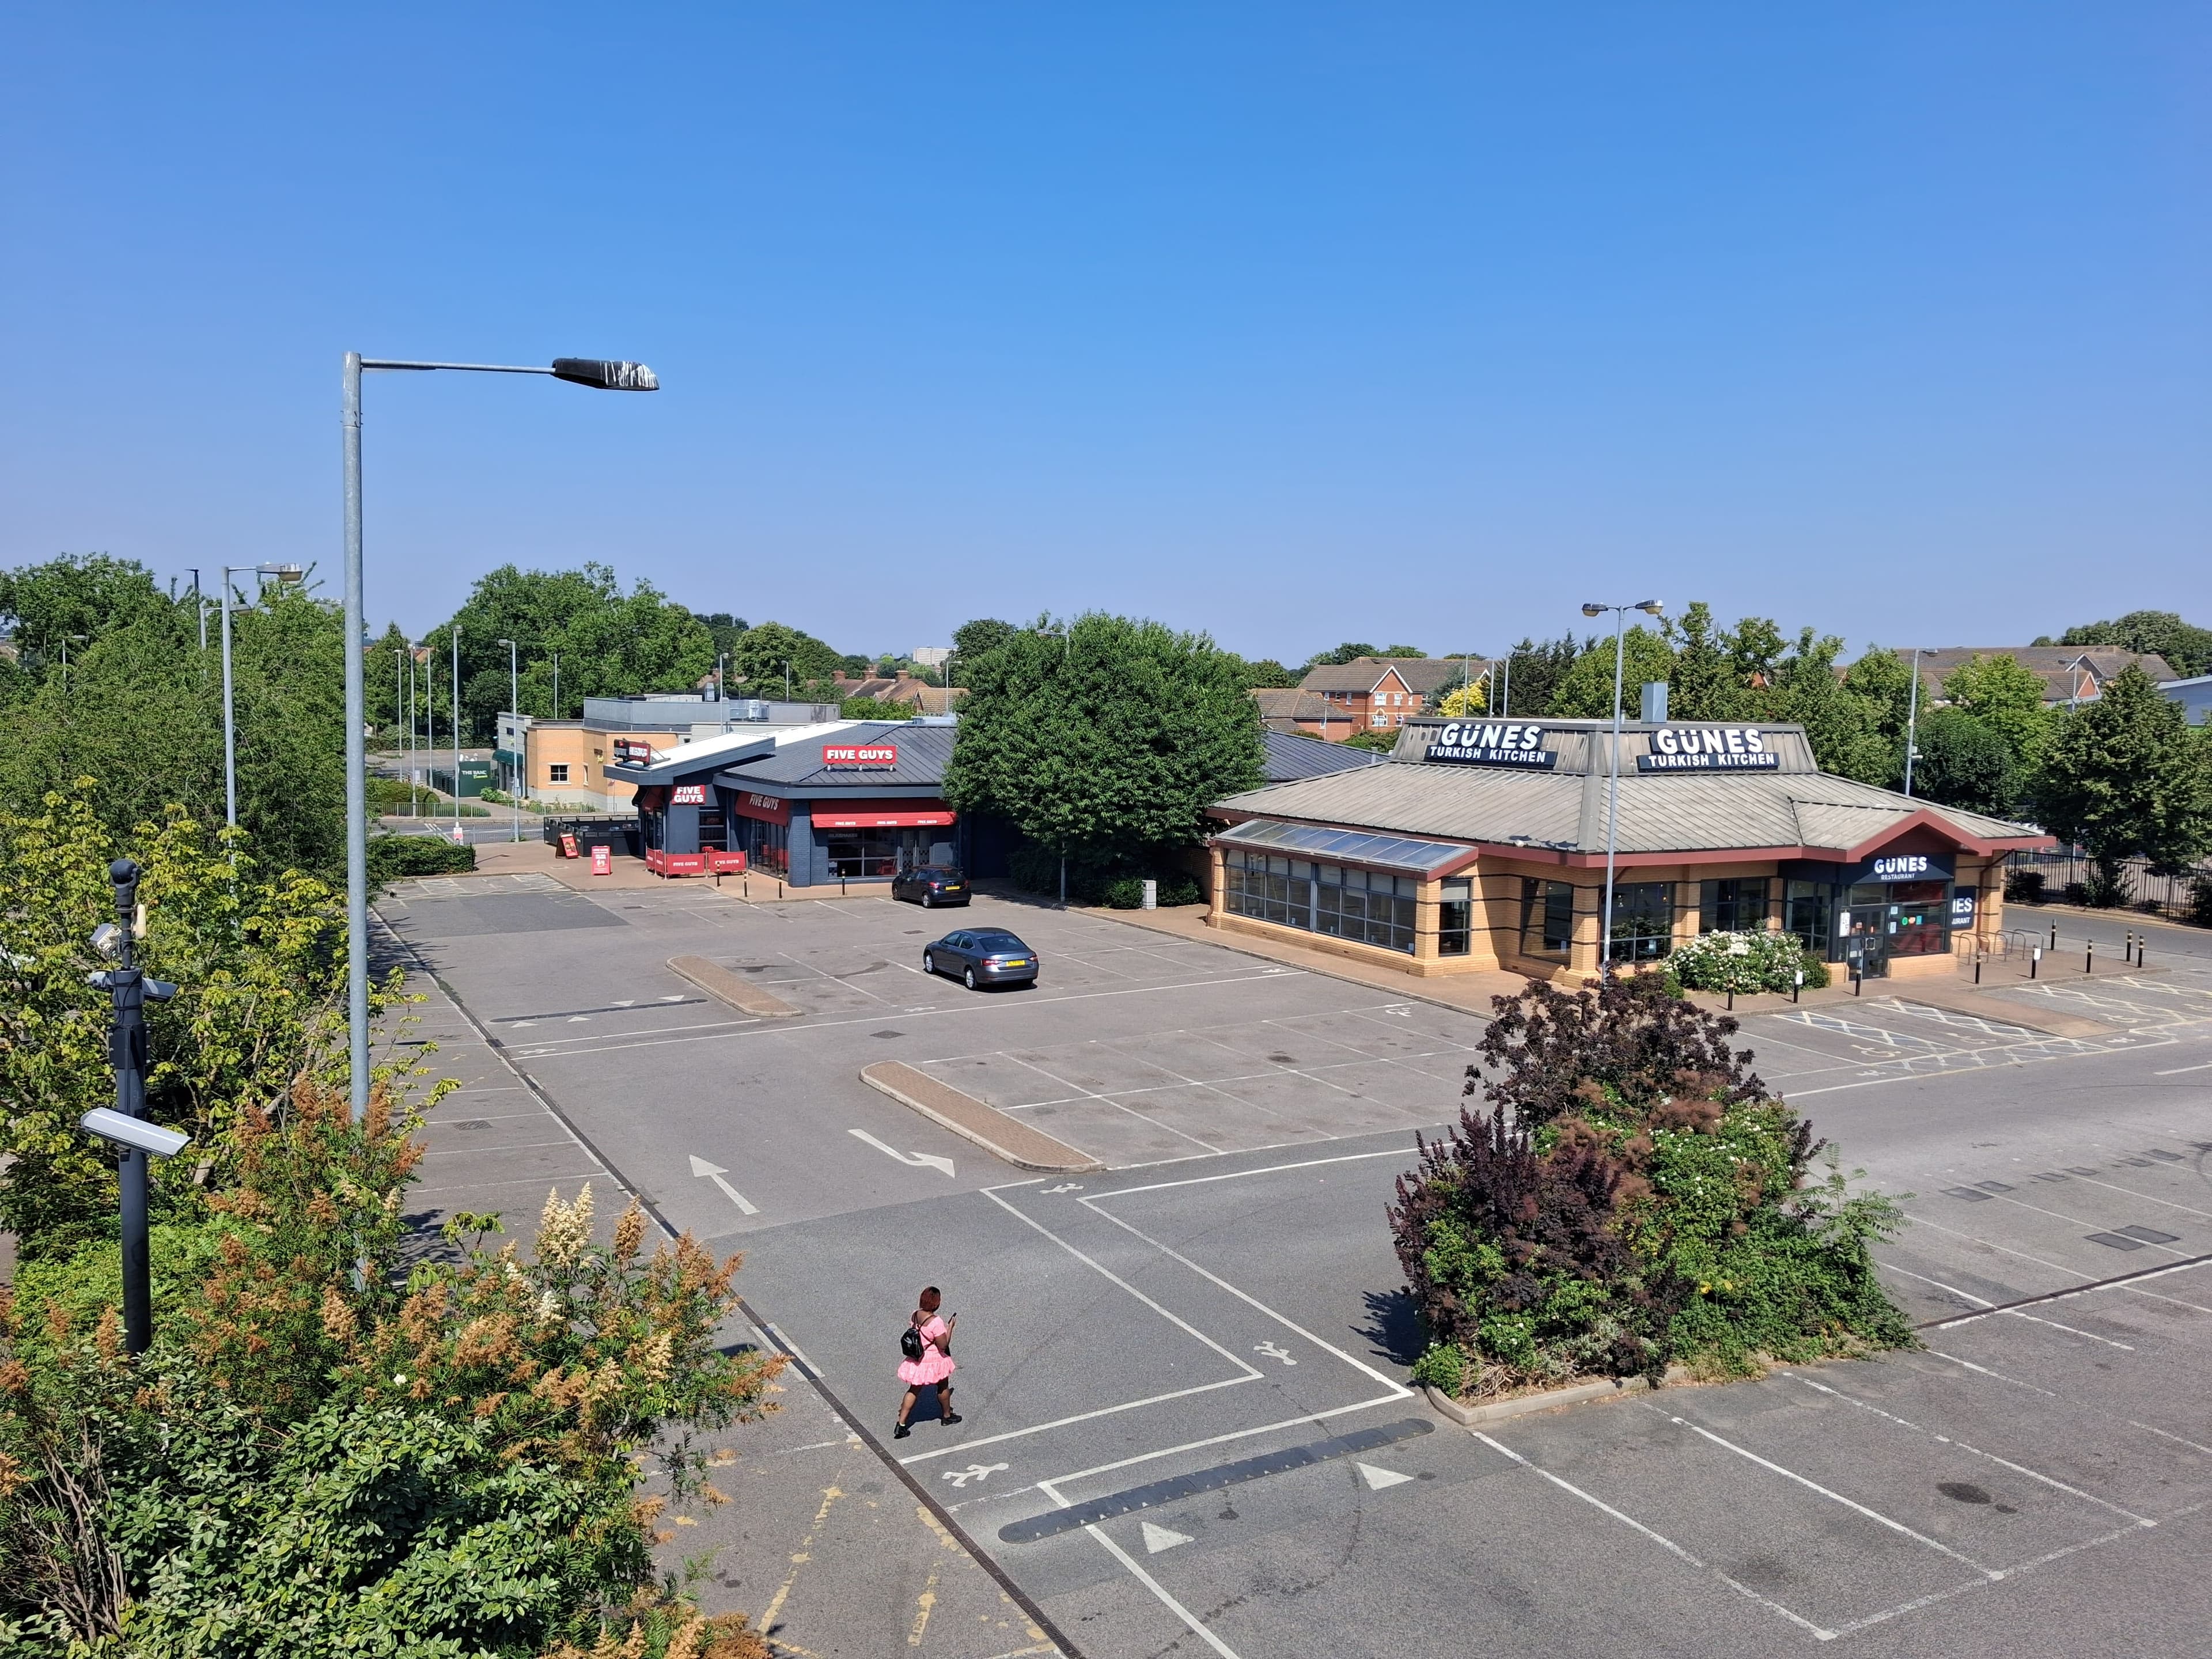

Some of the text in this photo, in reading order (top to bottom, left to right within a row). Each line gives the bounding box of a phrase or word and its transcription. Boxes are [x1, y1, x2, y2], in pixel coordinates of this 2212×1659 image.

[1441, 723, 1541, 750] GÜNES
[1657, 729, 1764, 755] GÜNES
[827, 749, 893, 760] FIVE GUYS
[1430, 747, 1546, 763] TURKISH KITCHEN
[1649, 753, 1775, 767] TURKISH KITCHEN
[676, 786, 701, 794] FIVE
[673, 794, 704, 803] GUYS
[749, 793, 779, 810] FIVE GUYS
[1874, 856, 1927, 874] GÜNES
